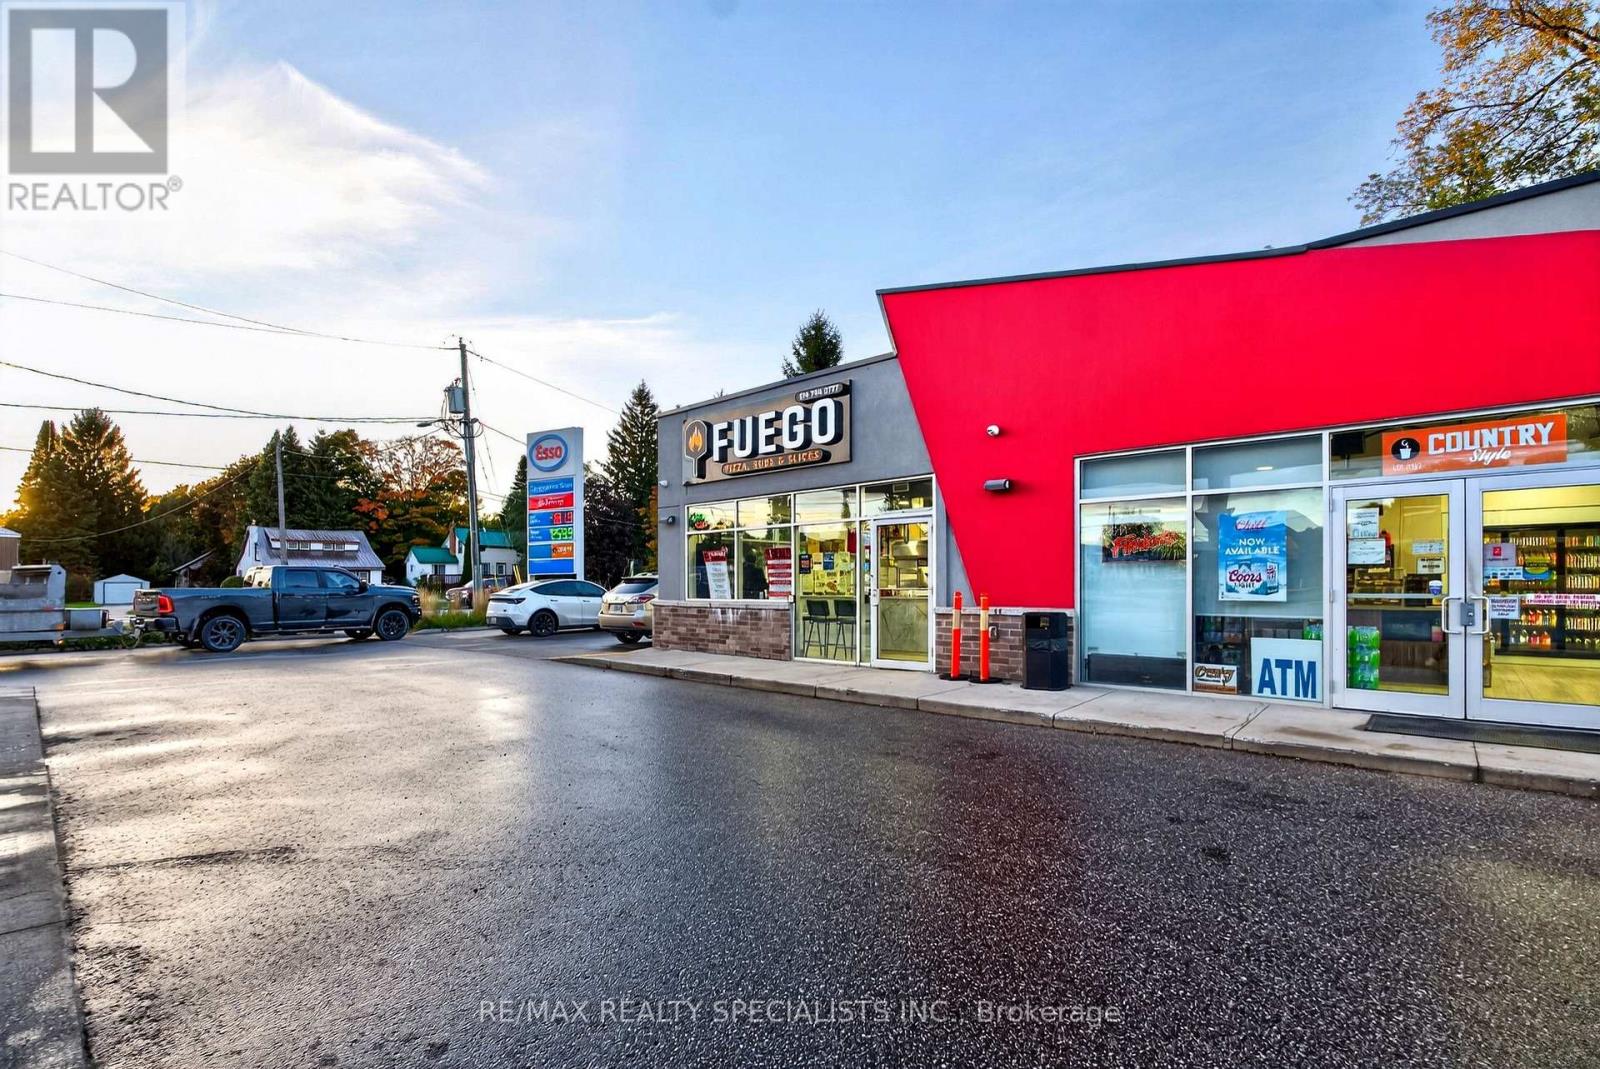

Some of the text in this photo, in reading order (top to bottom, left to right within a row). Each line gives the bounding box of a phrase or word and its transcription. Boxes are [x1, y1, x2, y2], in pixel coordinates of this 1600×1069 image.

[712, 398, 836, 462] FUEGO
[1427, 421, 1554, 455] COUNTRY
[534, 444, 563, 461] Esso
[1468, 446, 1512, 465] Style
[1225, 546, 1280, 555] AVAILABLE
[1239, 538, 1266, 546] NOW
[1229, 569, 1263, 583] Coors
[1257, 657, 1317, 700] ATM
